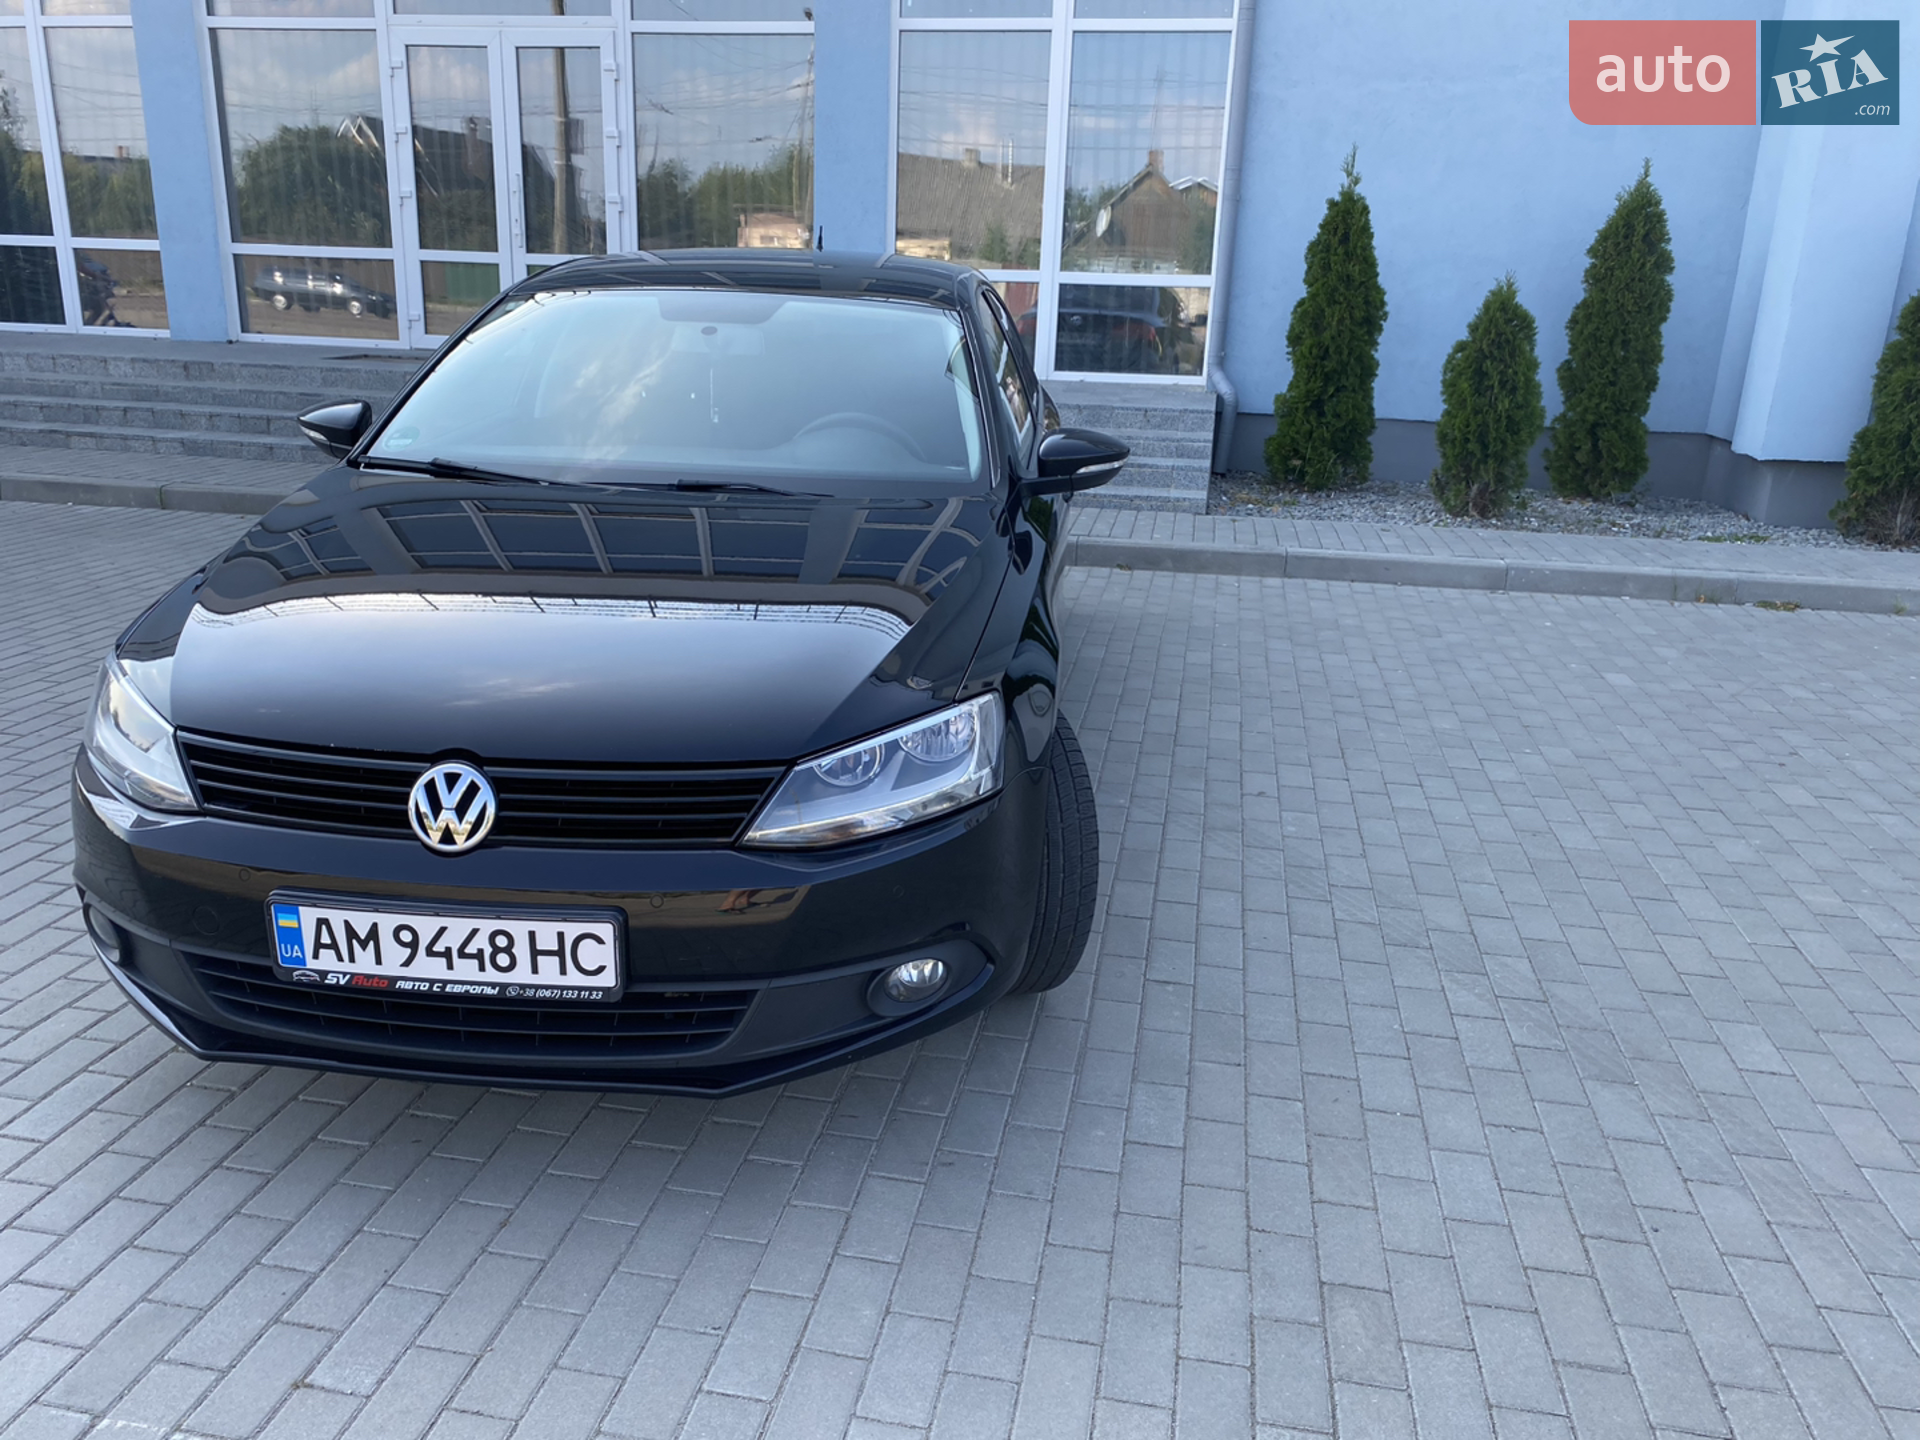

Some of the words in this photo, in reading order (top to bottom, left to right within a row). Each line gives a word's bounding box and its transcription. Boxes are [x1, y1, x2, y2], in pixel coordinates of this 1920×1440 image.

[410, 764, 494, 851] VW
[281, 943, 304, 958] UA
[311, 917, 383, 966] AM
[392, 923, 518, 974] 9448
[527, 930, 608, 977] HC
[324, 972, 351, 985] SV
[351, 975, 389, 988] Auto
[395, 980, 430, 991] АВТО
[445, 983, 500, 995] ЕВРОПЫ
[536, 988, 561, 999] (067)
[562, 989, 579, 999] 133
[580, 990, 589, 999] 11
[590, 991, 604, 1000] 33
